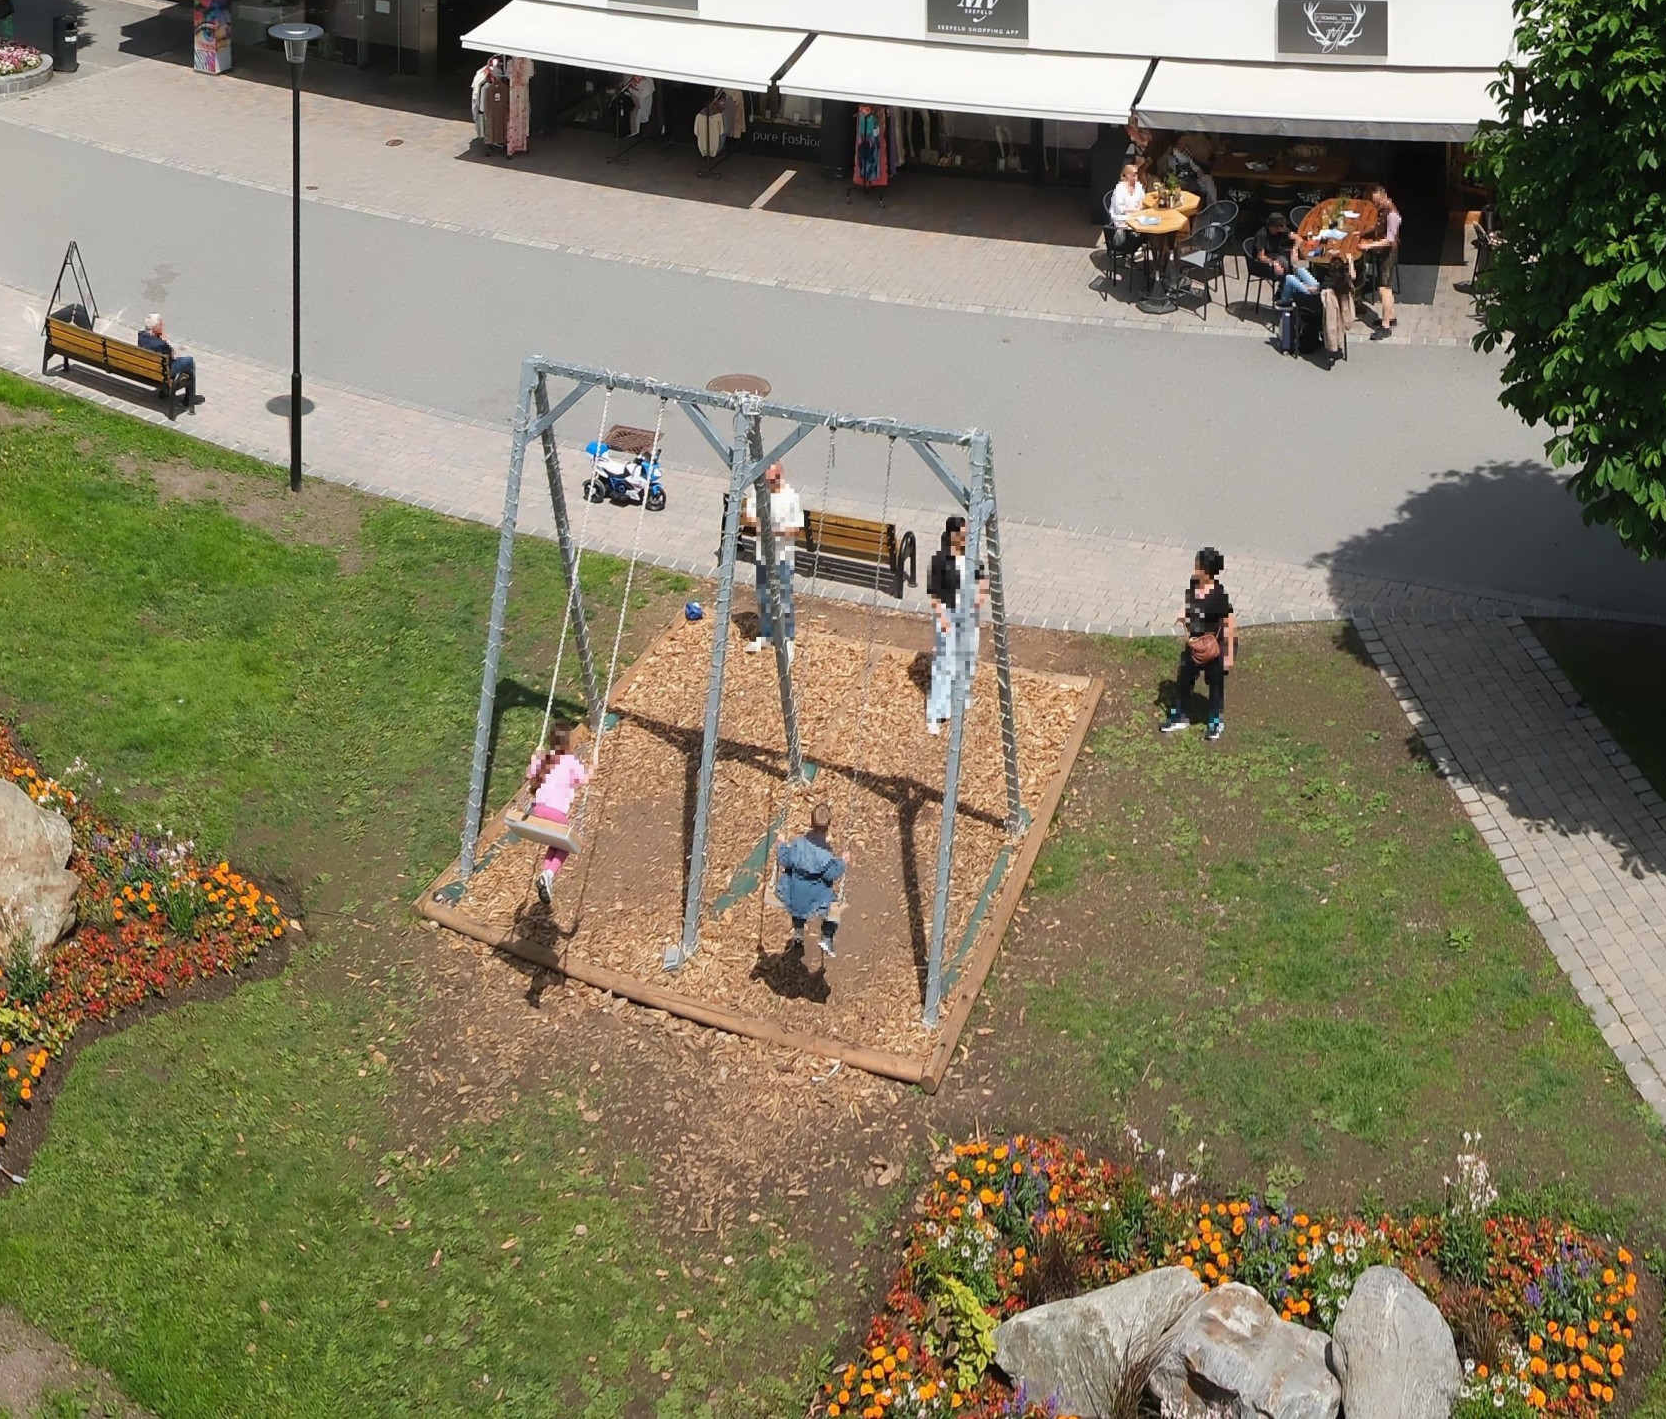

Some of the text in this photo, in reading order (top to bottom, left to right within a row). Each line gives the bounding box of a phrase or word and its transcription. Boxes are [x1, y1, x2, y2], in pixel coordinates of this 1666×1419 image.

[937, 24, 966, 32] SEEFELD
[968, 26, 1004, 34] SHOPPING
[752, 131, 779, 143] pure
